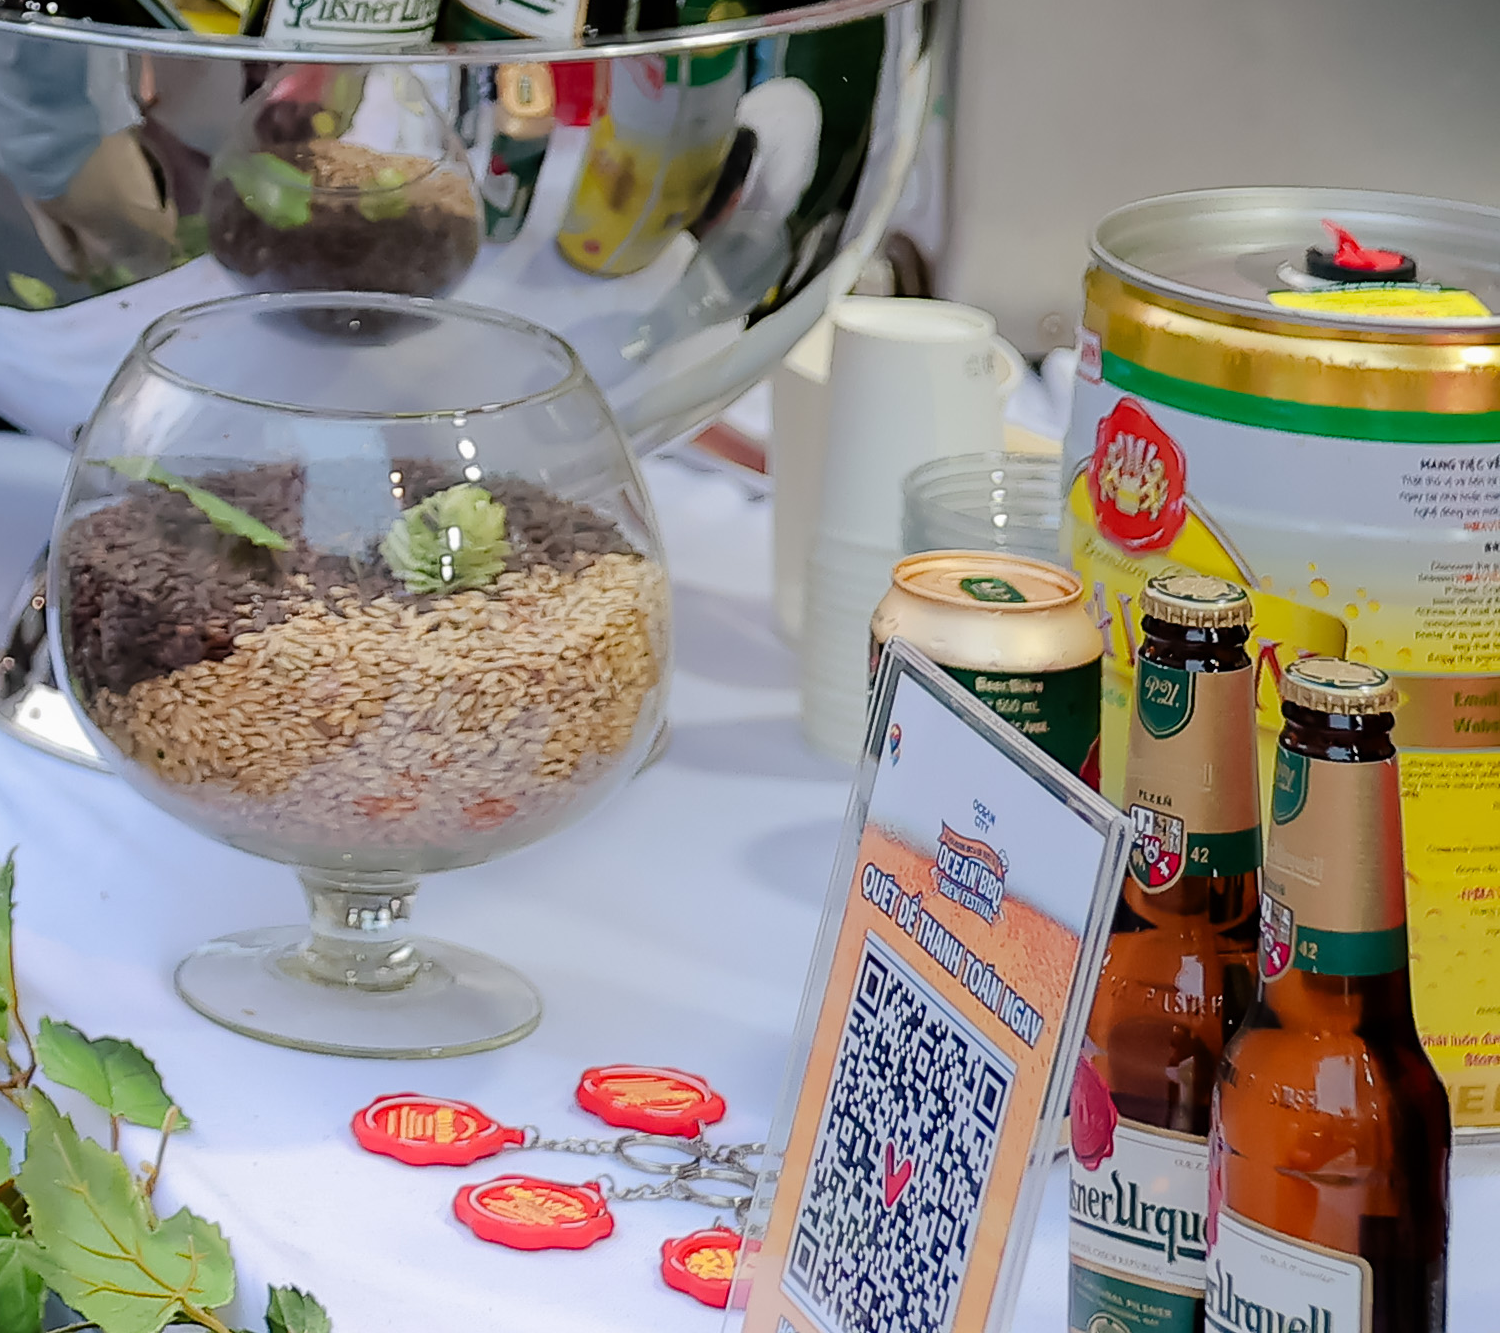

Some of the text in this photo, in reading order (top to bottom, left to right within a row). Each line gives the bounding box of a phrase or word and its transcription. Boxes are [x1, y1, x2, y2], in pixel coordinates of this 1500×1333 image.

[938, 843, 980, 891] OCEAN
[977, 869, 1003, 913] BBQ
[1190, 846, 1210, 864] 42
[960, 891, 995, 924] FESTIVAL
[915, 908, 966, 978] THANH
[961, 949, 1003, 1015] TOÁN
[999, 984, 1045, 1049] NGAY
[1298, 942, 1319, 960] 42
[1111, 1170, 1207, 1263] Urqu
[1215, 1258, 1334, 1333] Urquell
